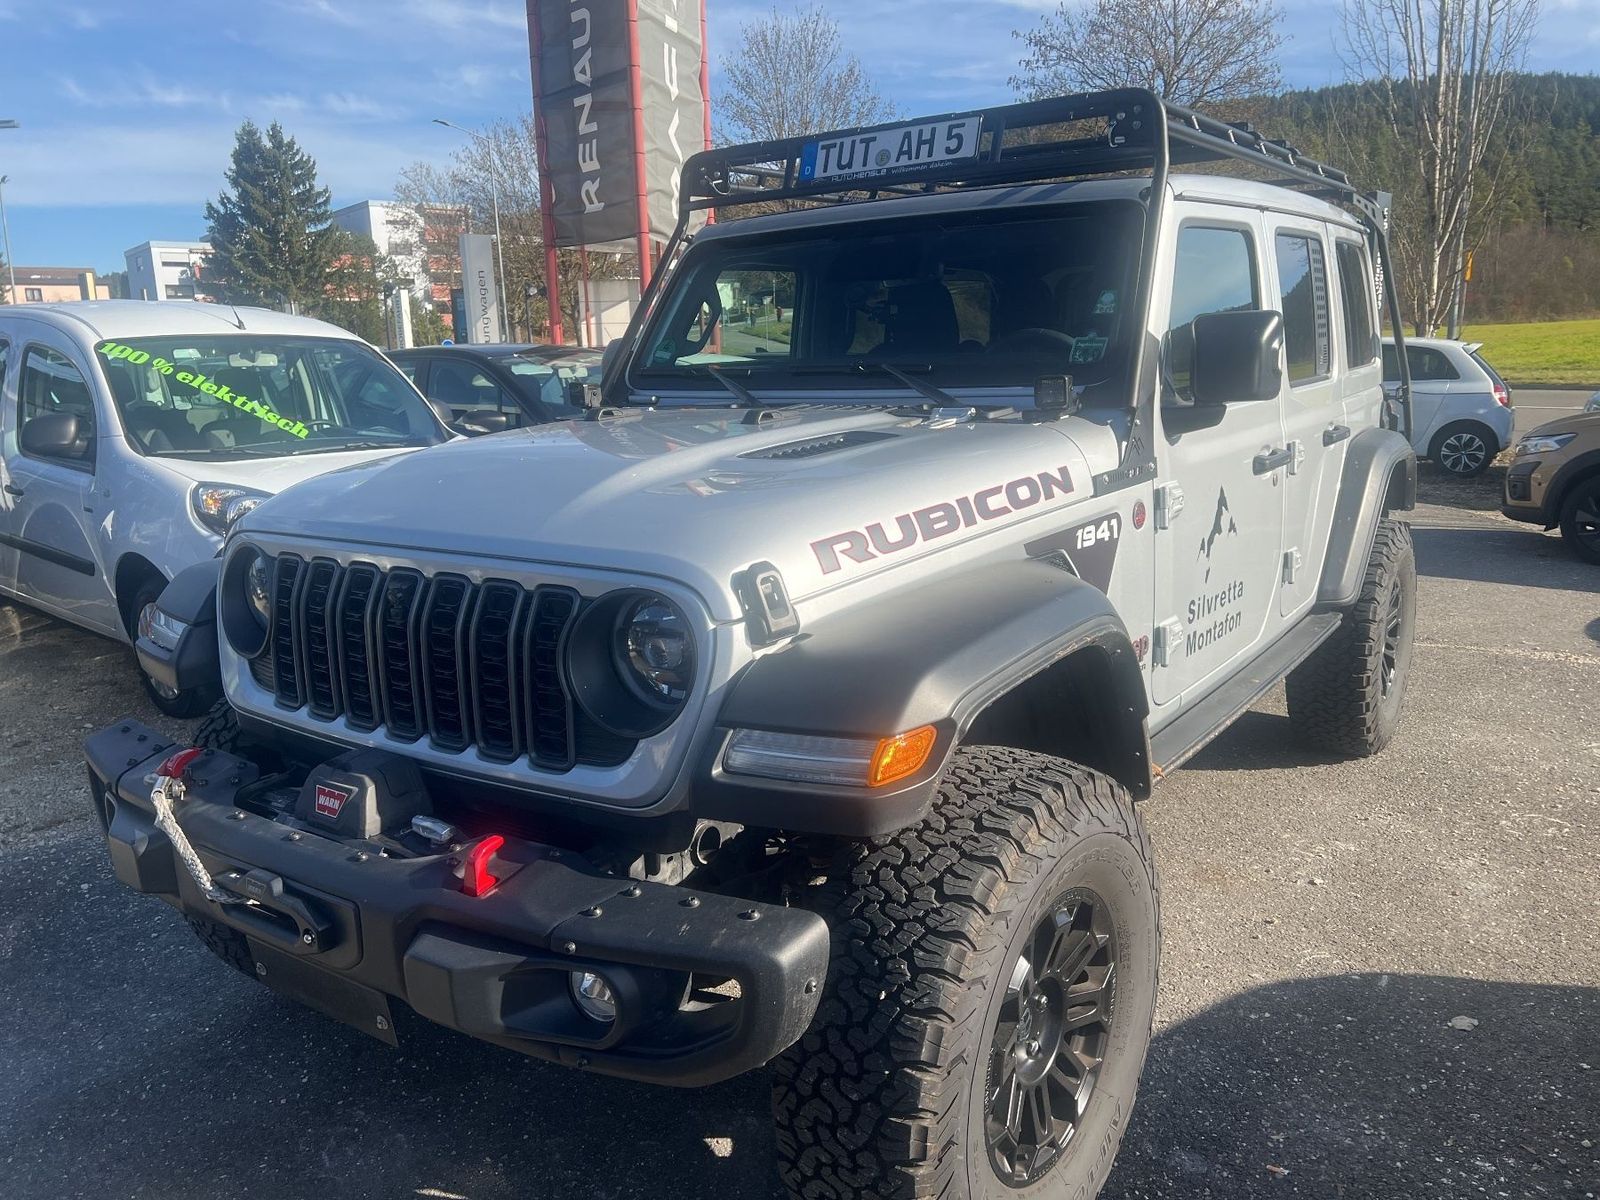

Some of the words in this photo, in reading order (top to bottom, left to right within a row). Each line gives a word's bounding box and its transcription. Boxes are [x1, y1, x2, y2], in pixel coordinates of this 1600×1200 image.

[570, 0, 605, 215] RENAU
[804, 166, 811, 176] D
[820, 136, 877, 173] TUT
[896, 126, 937, 163] AH
[944, 122, 966, 155] 5
[478, 270, 492, 344] ungwagen
[98, 342, 150, 365] 100
[152, 357, 175, 375] %
[175, 371, 310, 440] elektrisch
[809, 465, 1075, 576] RUBICON
[1075, 518, 1119, 550] 1941
[1187, 580, 1244, 625] Silvretta
[1185, 611, 1242, 658] Montafon
[318, 794, 340, 809] WARN
